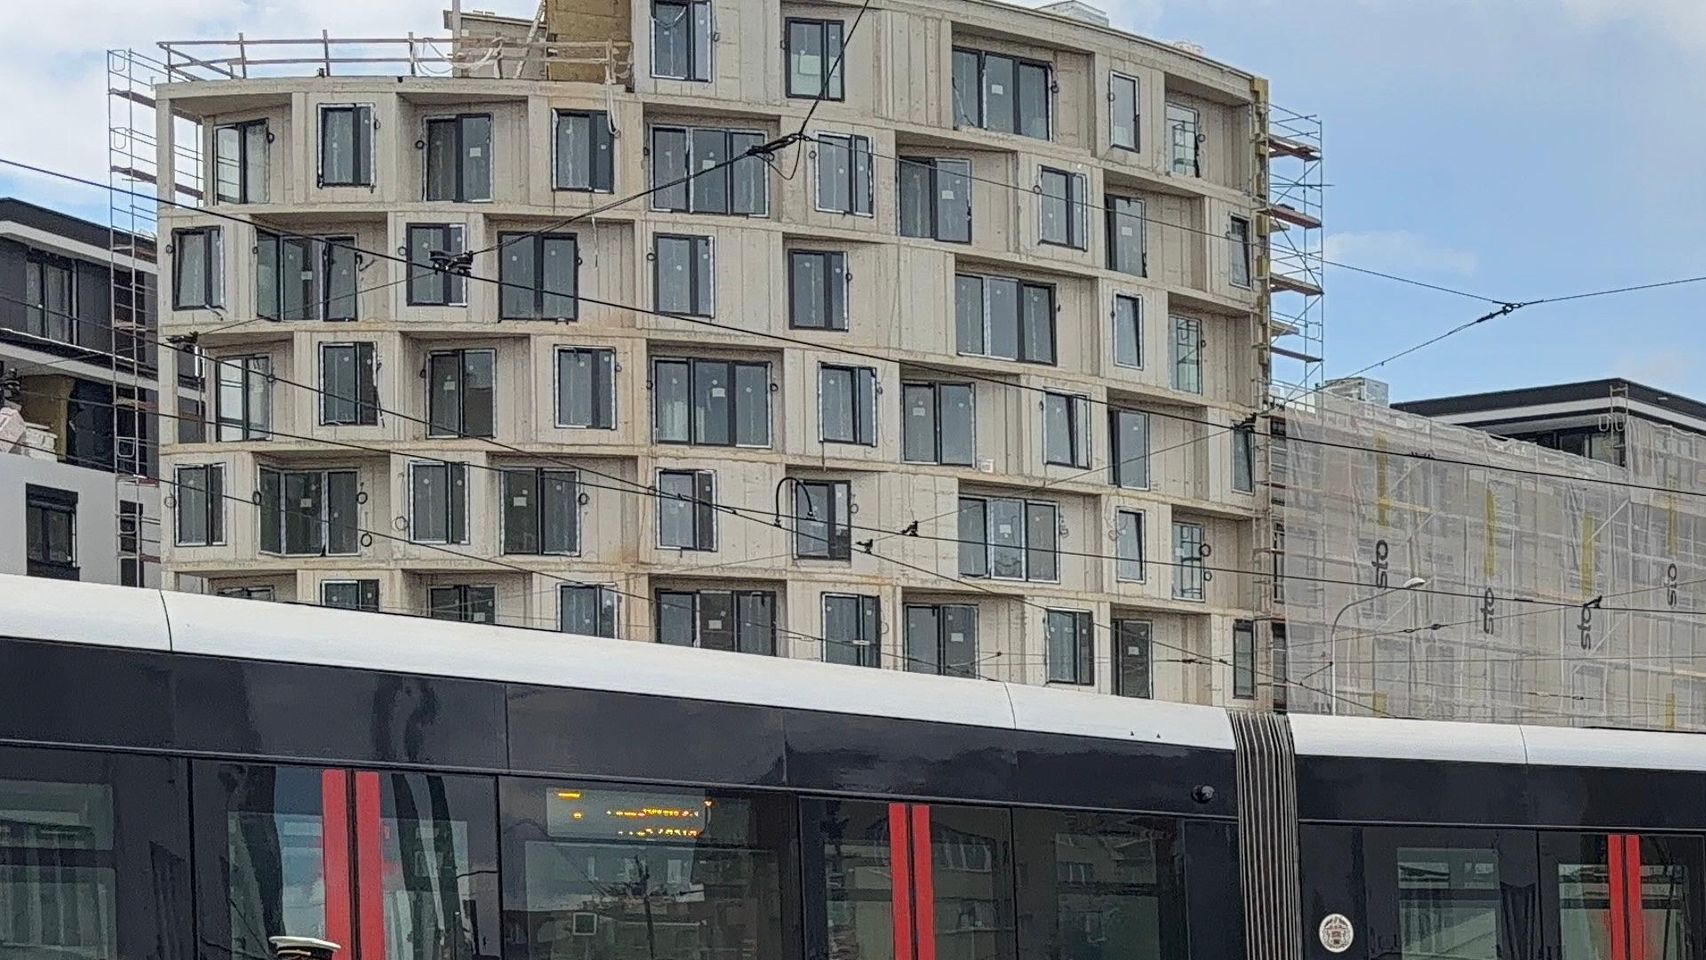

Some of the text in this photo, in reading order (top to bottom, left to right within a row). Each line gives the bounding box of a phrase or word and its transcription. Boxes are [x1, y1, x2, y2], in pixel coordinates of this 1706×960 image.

[1372, 540, 1388, 590] sto
[1480, 588, 1494, 634] sto
[1577, 604, 1591, 649] sto
